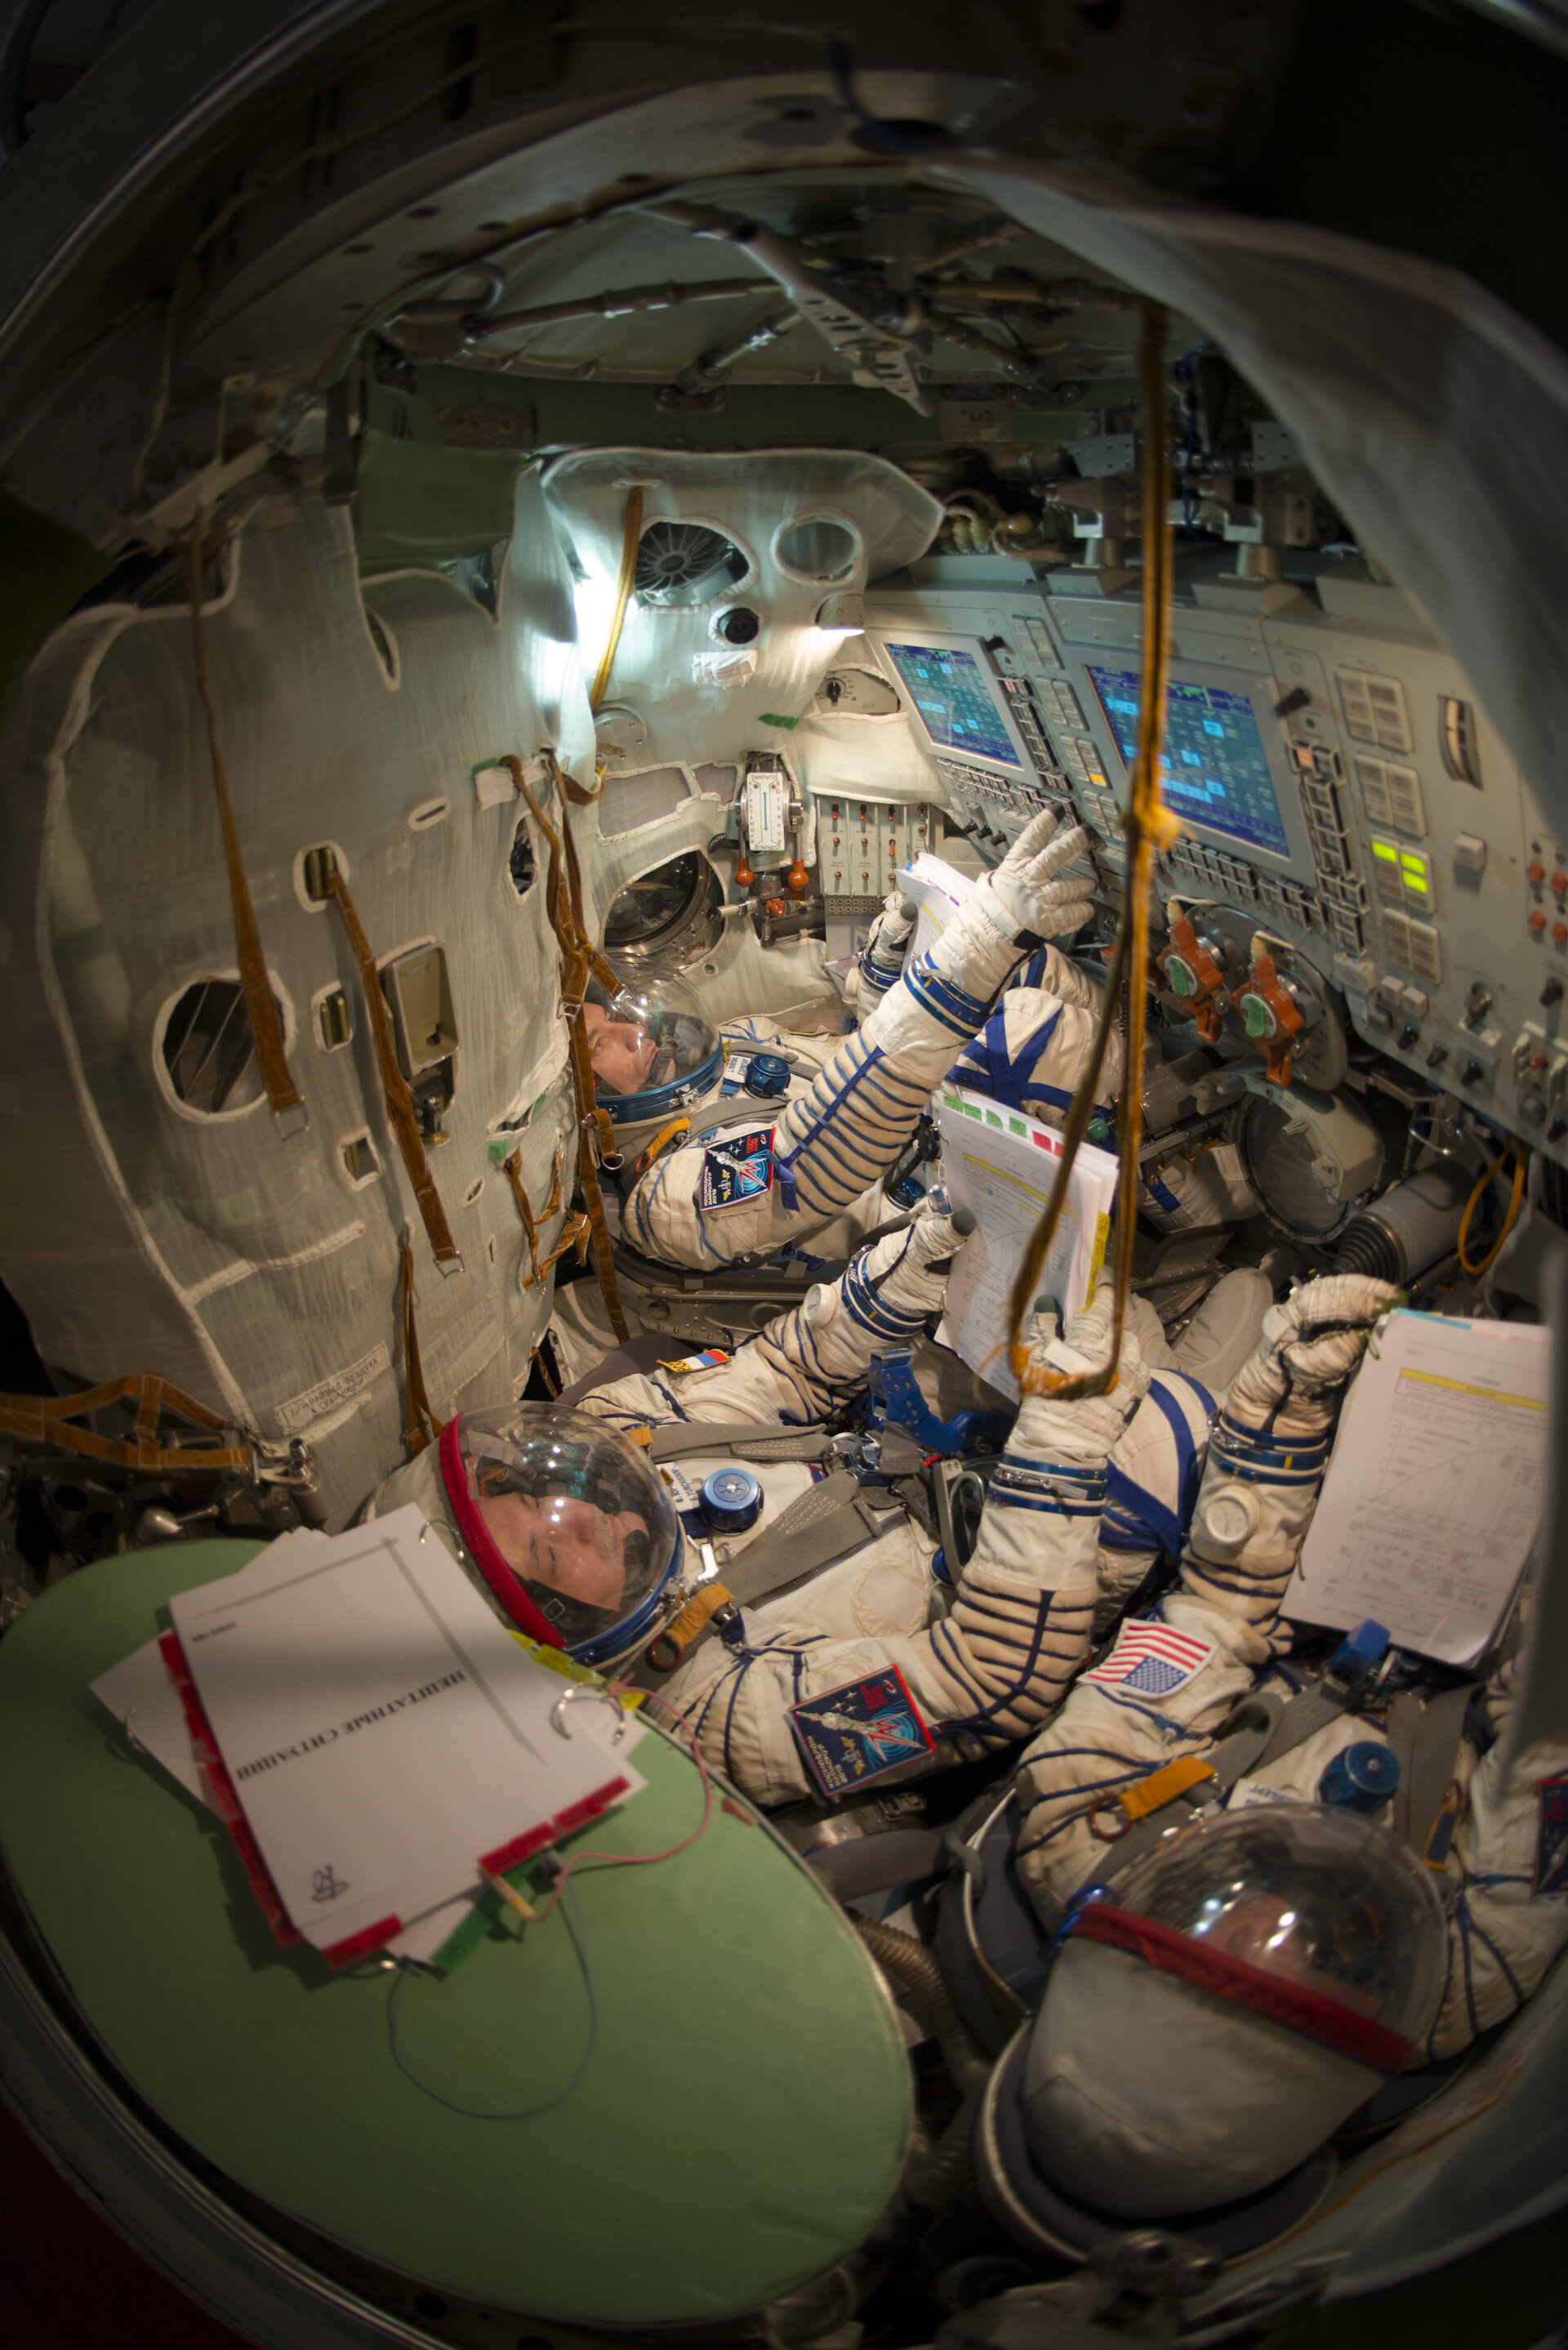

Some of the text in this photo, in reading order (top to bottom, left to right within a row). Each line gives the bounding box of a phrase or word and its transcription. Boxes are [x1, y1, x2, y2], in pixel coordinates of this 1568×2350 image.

[235, 1670, 467, 1781] НЕШТАТНЫЕ СИТУАЦИИ
[806, 1735, 835, 1789] КОСМОДРОМ
[817, 1743, 842, 1786] БАЙКОНУР
